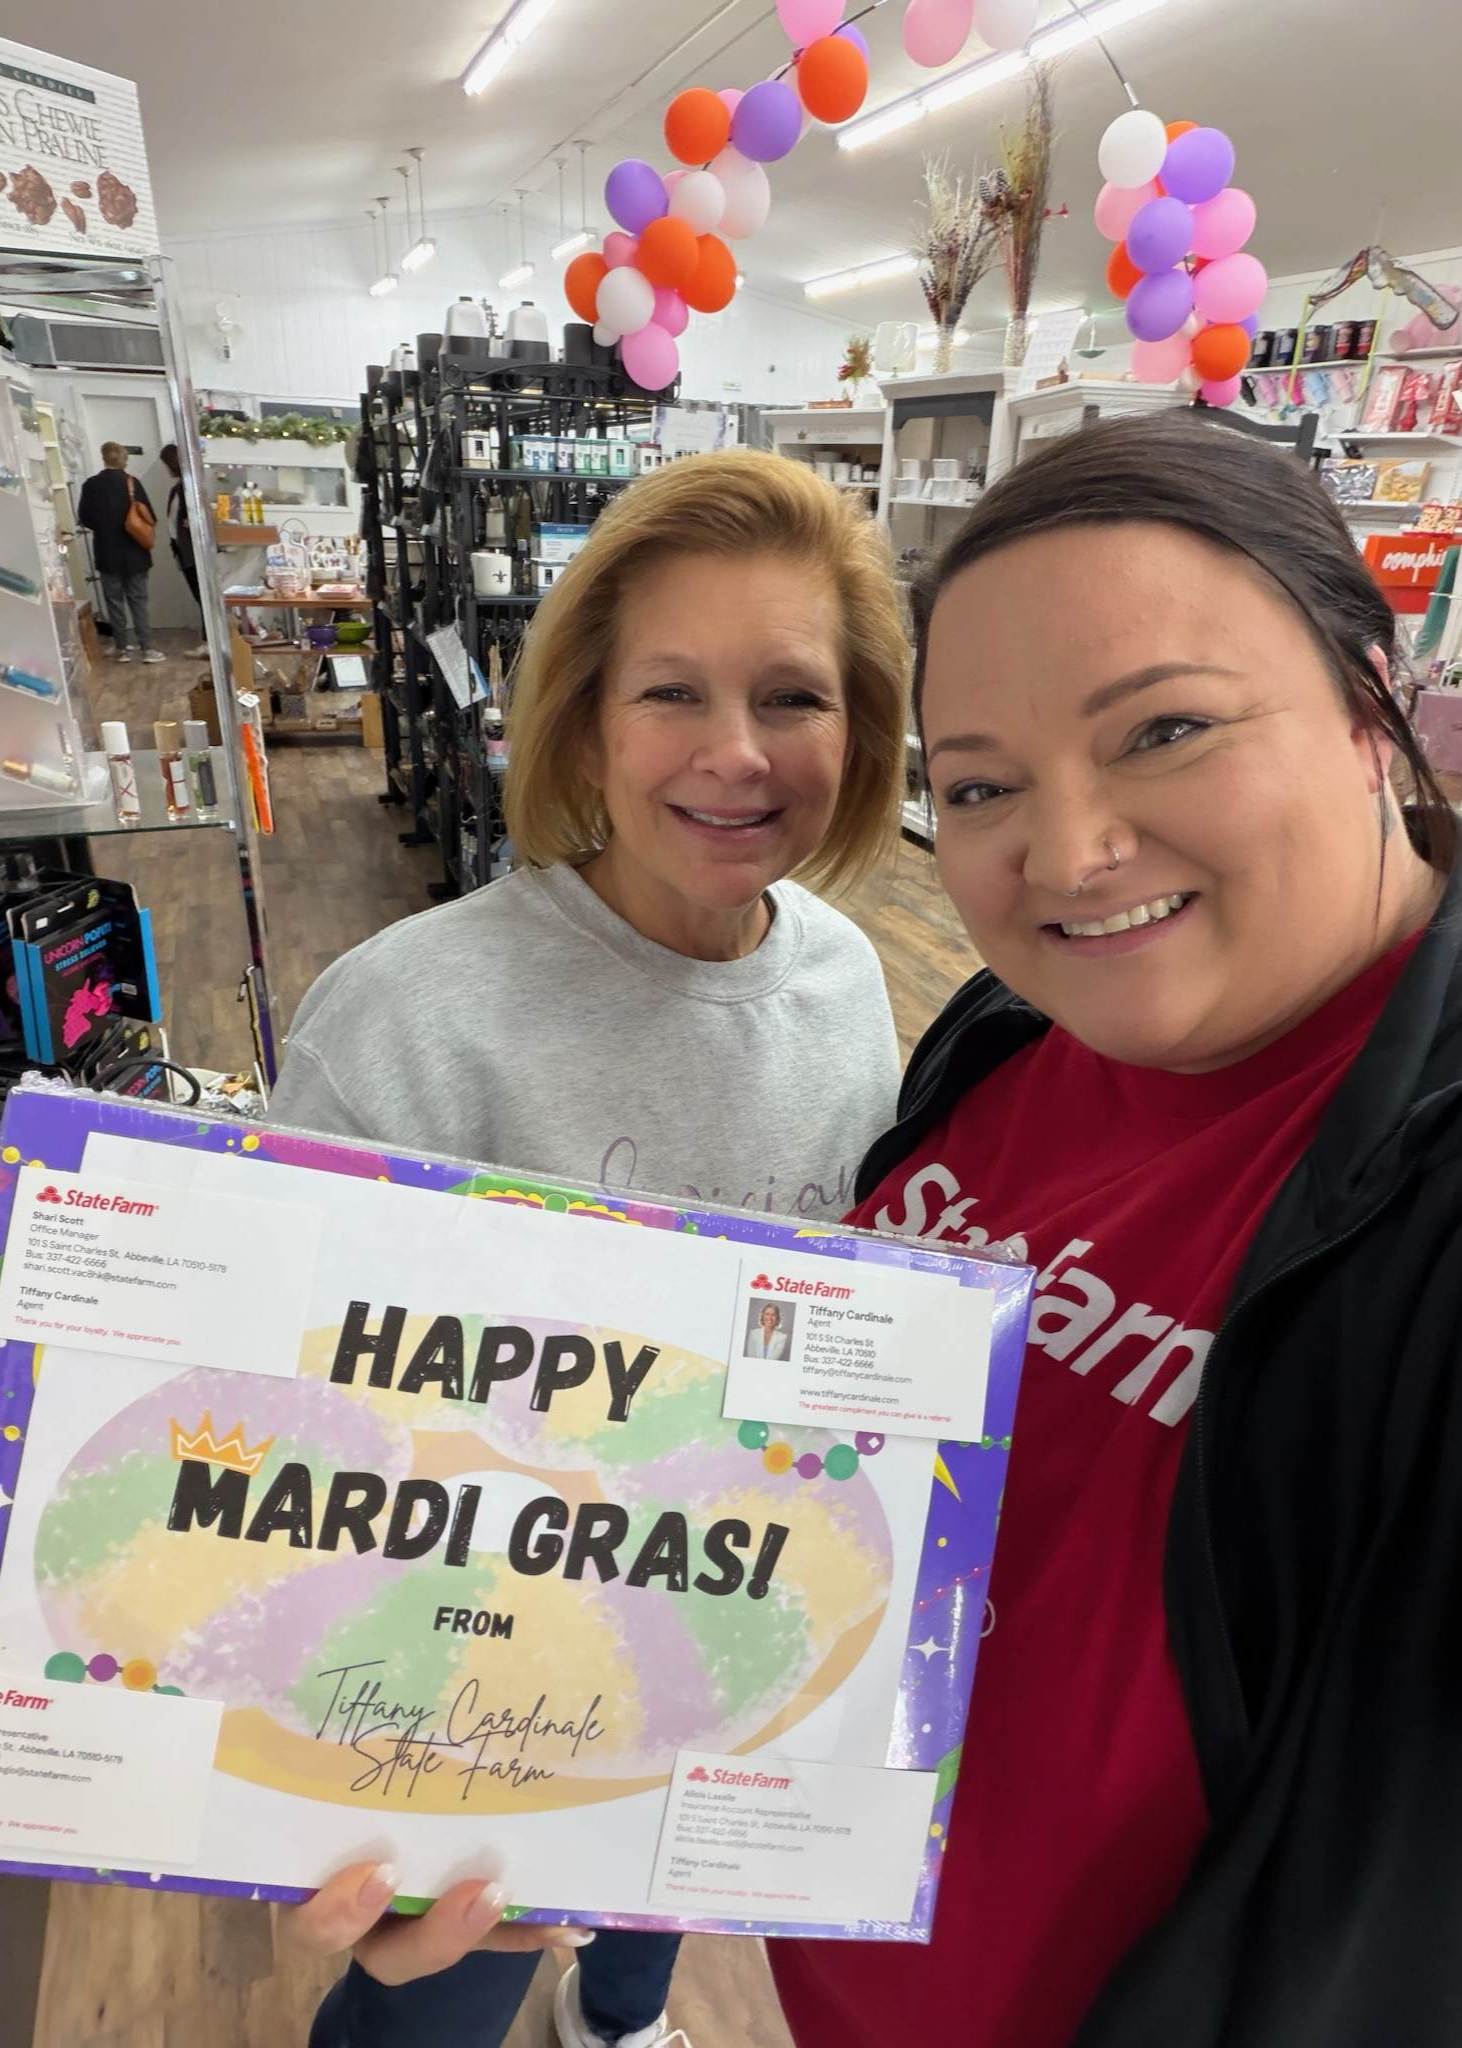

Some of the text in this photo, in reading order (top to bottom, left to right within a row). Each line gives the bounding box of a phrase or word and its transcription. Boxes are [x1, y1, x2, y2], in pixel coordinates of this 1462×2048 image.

[14, 88, 103, 141] CHEWIE
[21, 114, 110, 169] PRALINE
[1381, 542, 1447, 583] oomphi
[32, 1211, 84, 1226] Shari Scott
[30, 1223, 100, 1241] Office Manager
[28, 1237, 41, 1247] 101
[41, 1239, 48, 1248] S
[48, 1240, 72, 1250] Saint
[73, 1244, 107, 1257] Charles
[166, 1257, 180, 1267] LA
[16, 1299, 44, 1311] Agent
[20, 1286, 99, 1305] Tiffany Cardinale
[807, 1318, 831, 1328] Agent
[809, 1305, 894, 1325] Tiffany Cardinale
[834, 1335, 864, 1346] Charles
[329, 1300, 661, 1423] HAPPY
[842, 1347, 853, 1356] LA
[854, 1348, 876, 1359] 70510
[802, 1365, 913, 1384] tiffany@tiffanycardinale.com
[800, 1388, 900, 1405] www.tiffanycardinale.com
[167, 1458, 790, 1601] MARDI GRAS!
[433, 1605, 515, 1639] FROM
[315, 1660, 606, 1757] Tiffany Cardinale
[62, 1750, 75, 1758] LA
[350, 1722, 556, 1800] State Farm
[671, 1856, 741, 1871] Tiffany Cardinale
